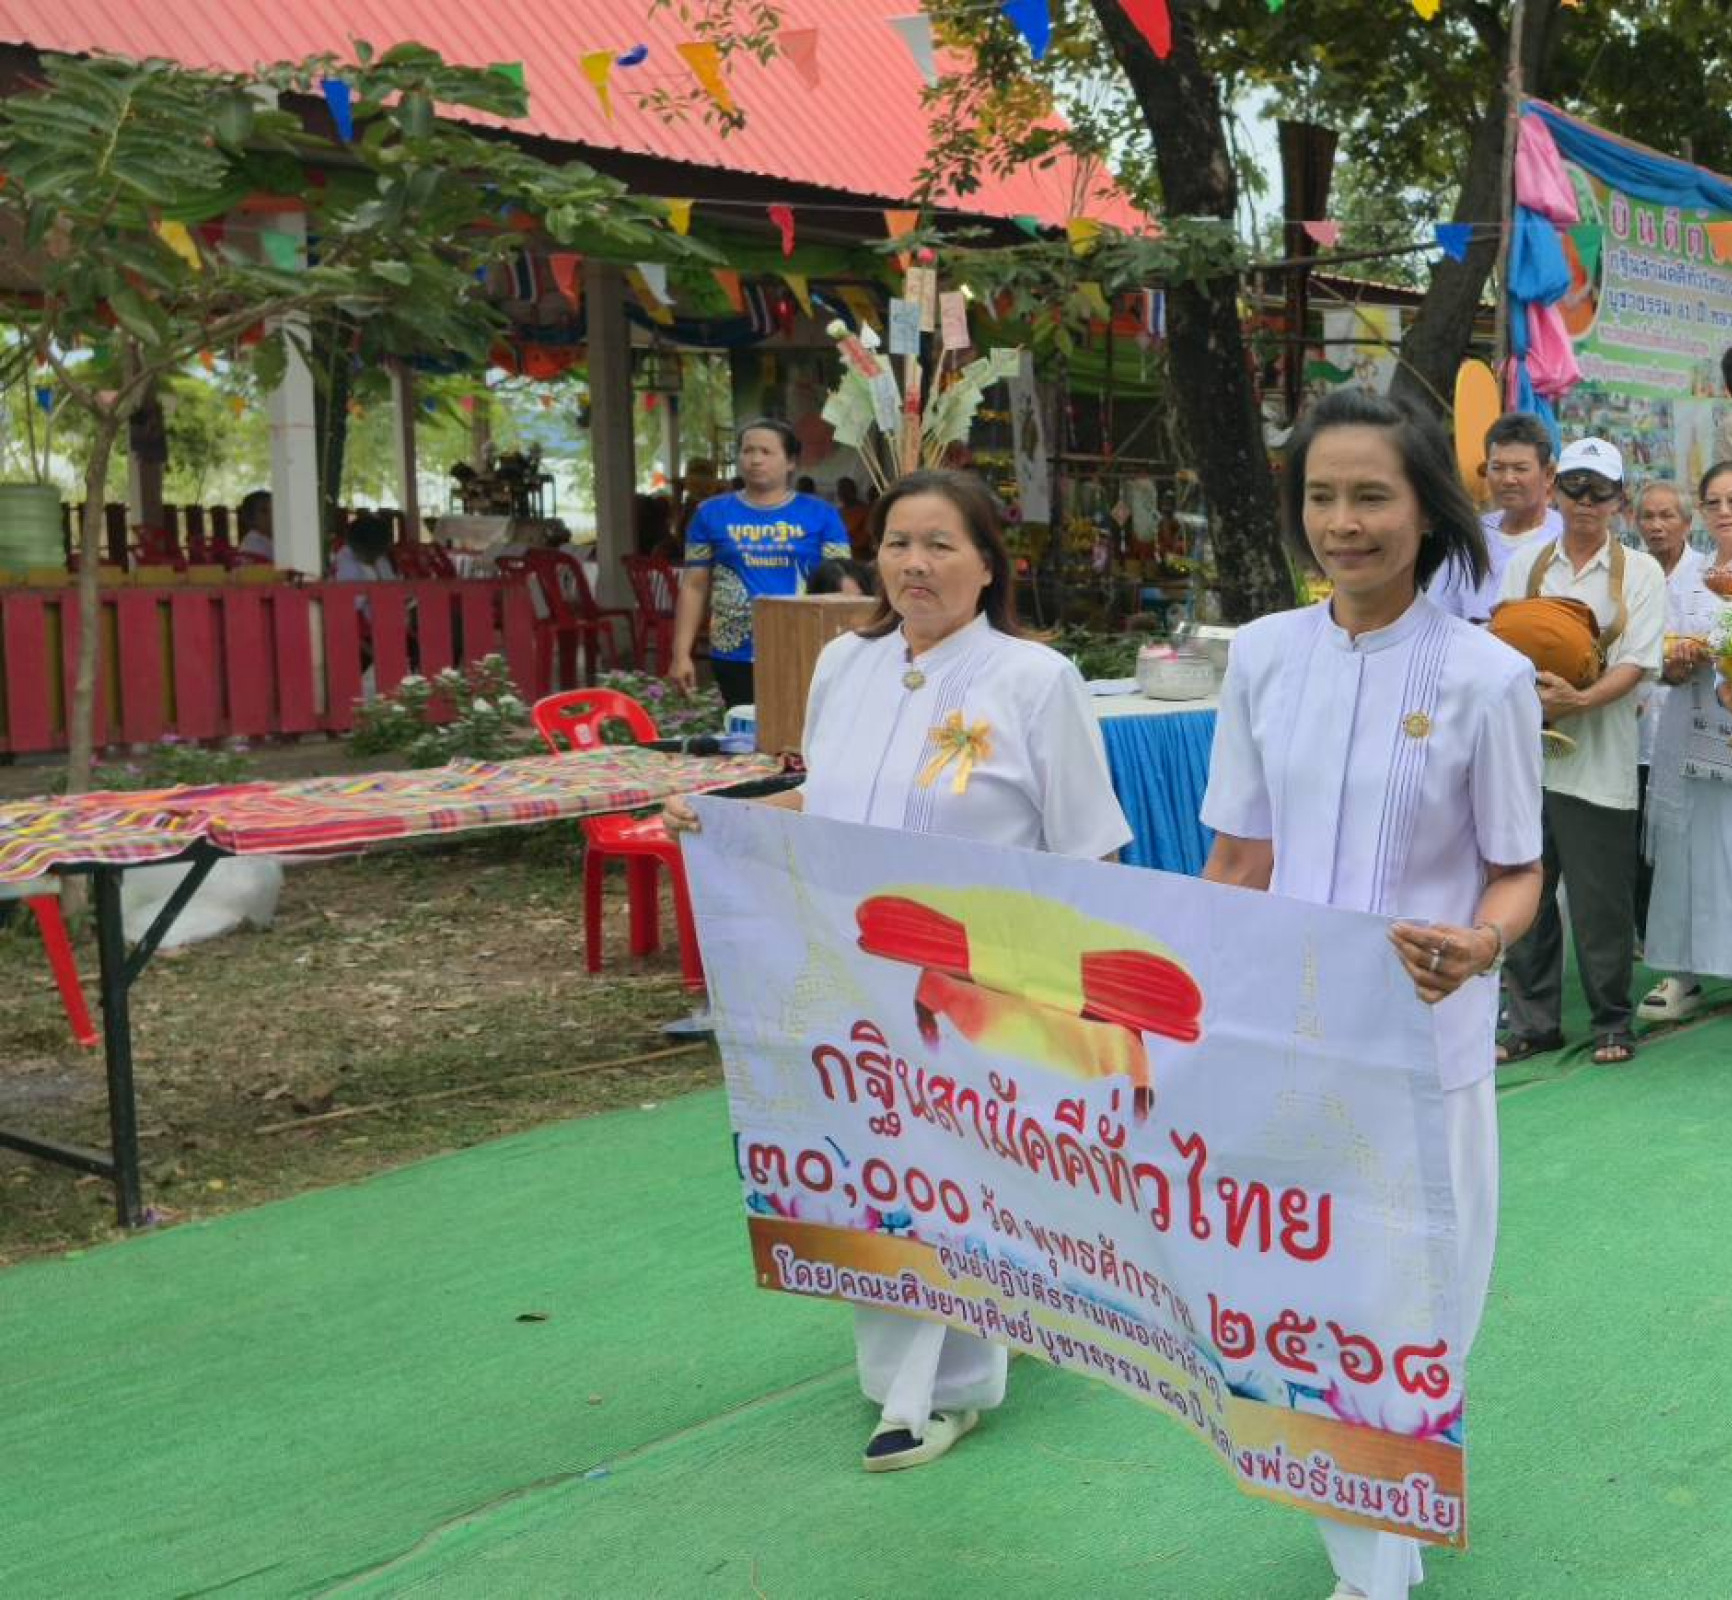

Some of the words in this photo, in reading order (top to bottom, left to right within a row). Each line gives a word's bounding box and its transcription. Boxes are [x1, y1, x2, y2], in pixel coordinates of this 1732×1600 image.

[811, 1019, 1333, 1263] กฐินสามัคคีทั่วไทย
[1207, 1292, 1451, 1400] ๒๕๖๘
[1208, 1415, 1455, 1529] หลงพ่อธัมมชโย
